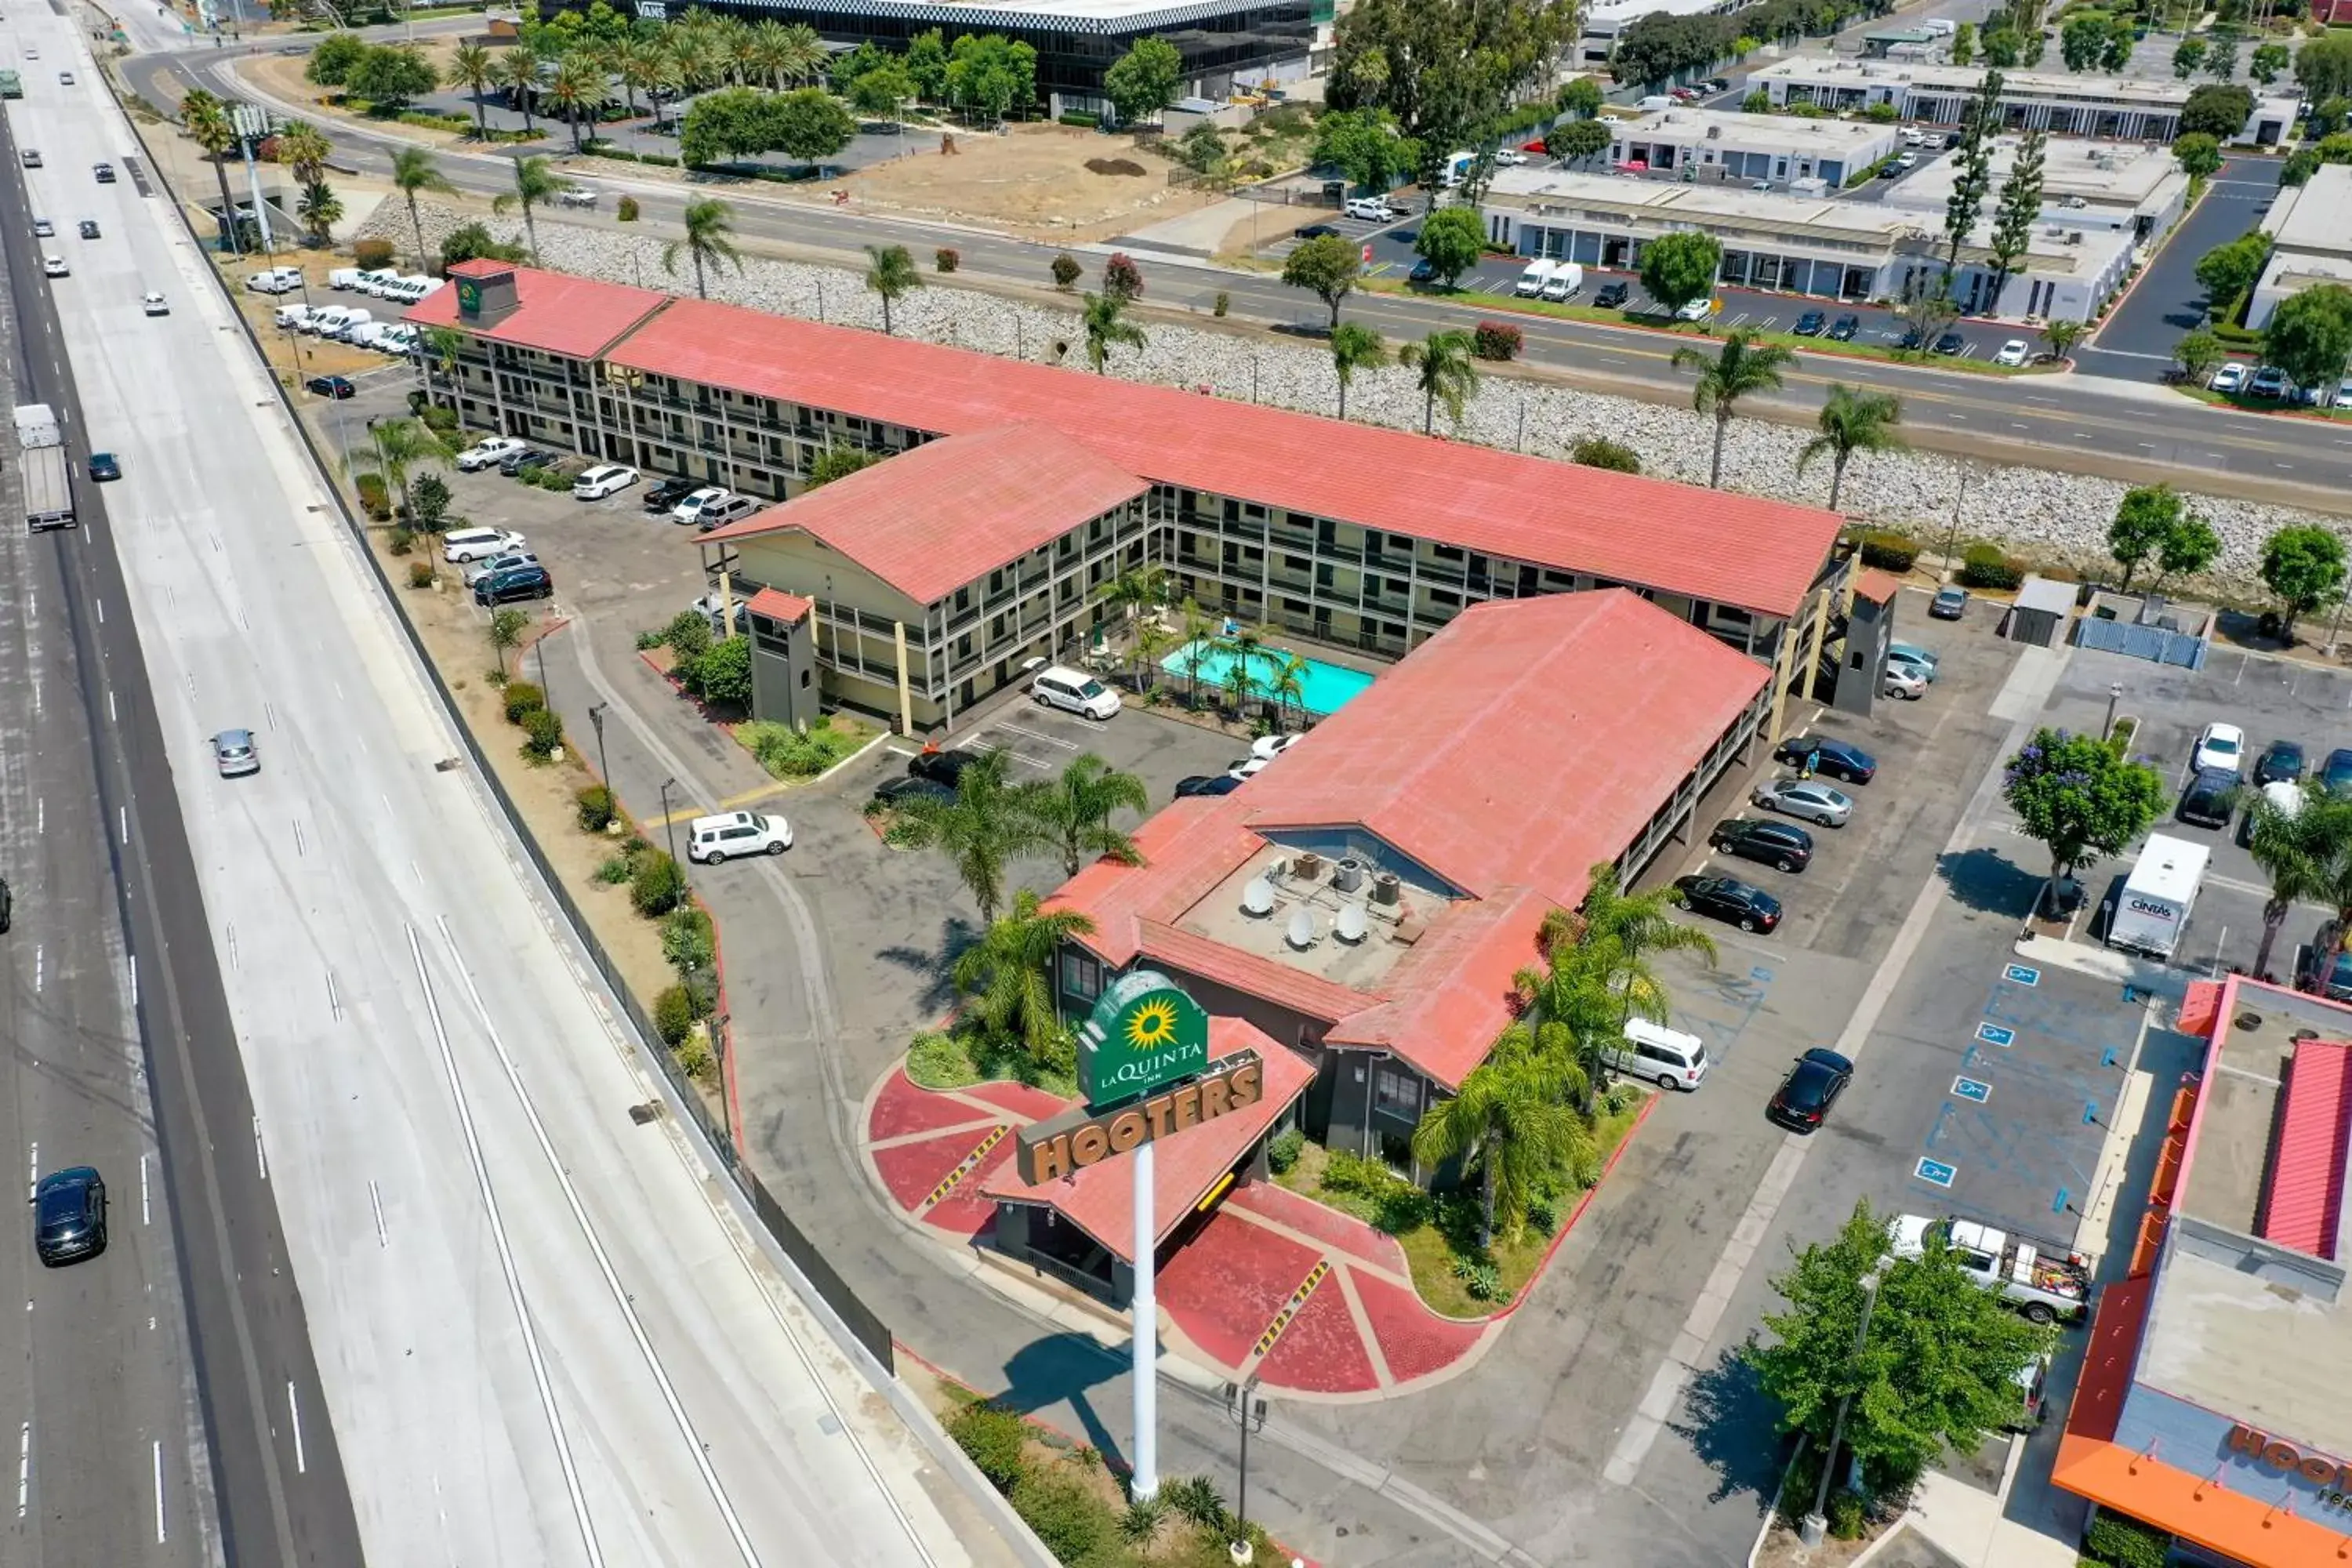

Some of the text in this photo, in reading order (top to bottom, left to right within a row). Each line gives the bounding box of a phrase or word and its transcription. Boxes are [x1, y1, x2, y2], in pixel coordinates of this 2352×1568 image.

[635, 0, 666, 19] VANS
[2132, 898, 2171, 916] CINTAS
[1102, 1042, 1203, 1089] LA QUINTA
[1144, 1073, 1162, 1085] INN
[1032, 1065, 1258, 1185] HOOTERS
